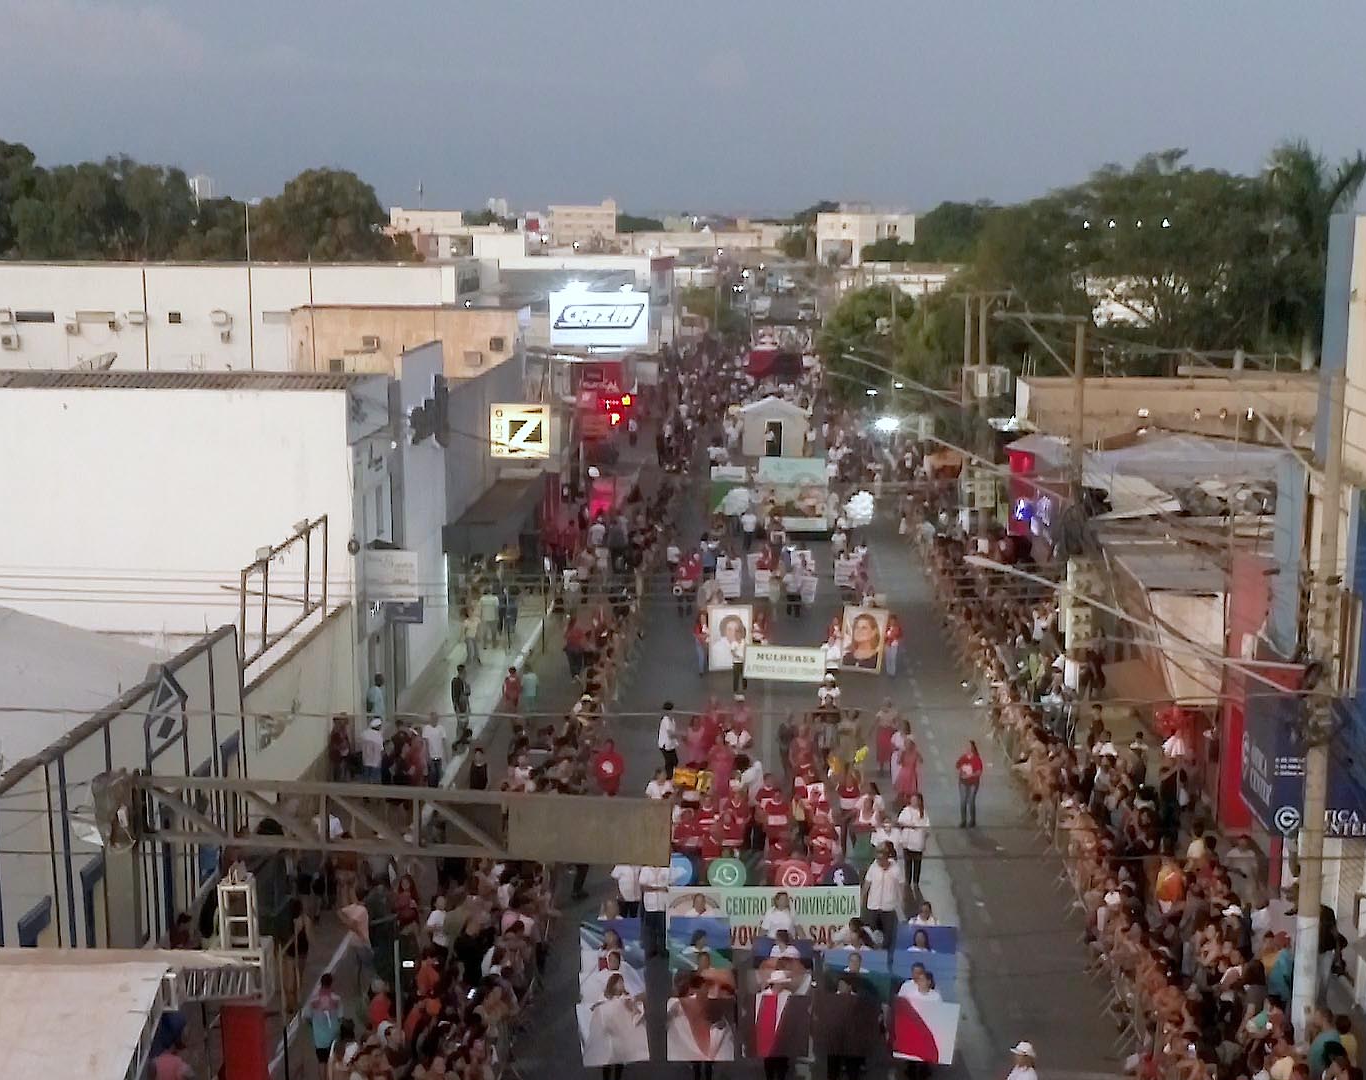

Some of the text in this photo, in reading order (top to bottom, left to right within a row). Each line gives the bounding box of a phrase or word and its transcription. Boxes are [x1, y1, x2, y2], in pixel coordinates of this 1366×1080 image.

[756, 652, 817, 664] MULHERES
[1324, 810, 1360, 823] TICA
[726, 896, 767, 916] CENTRO
